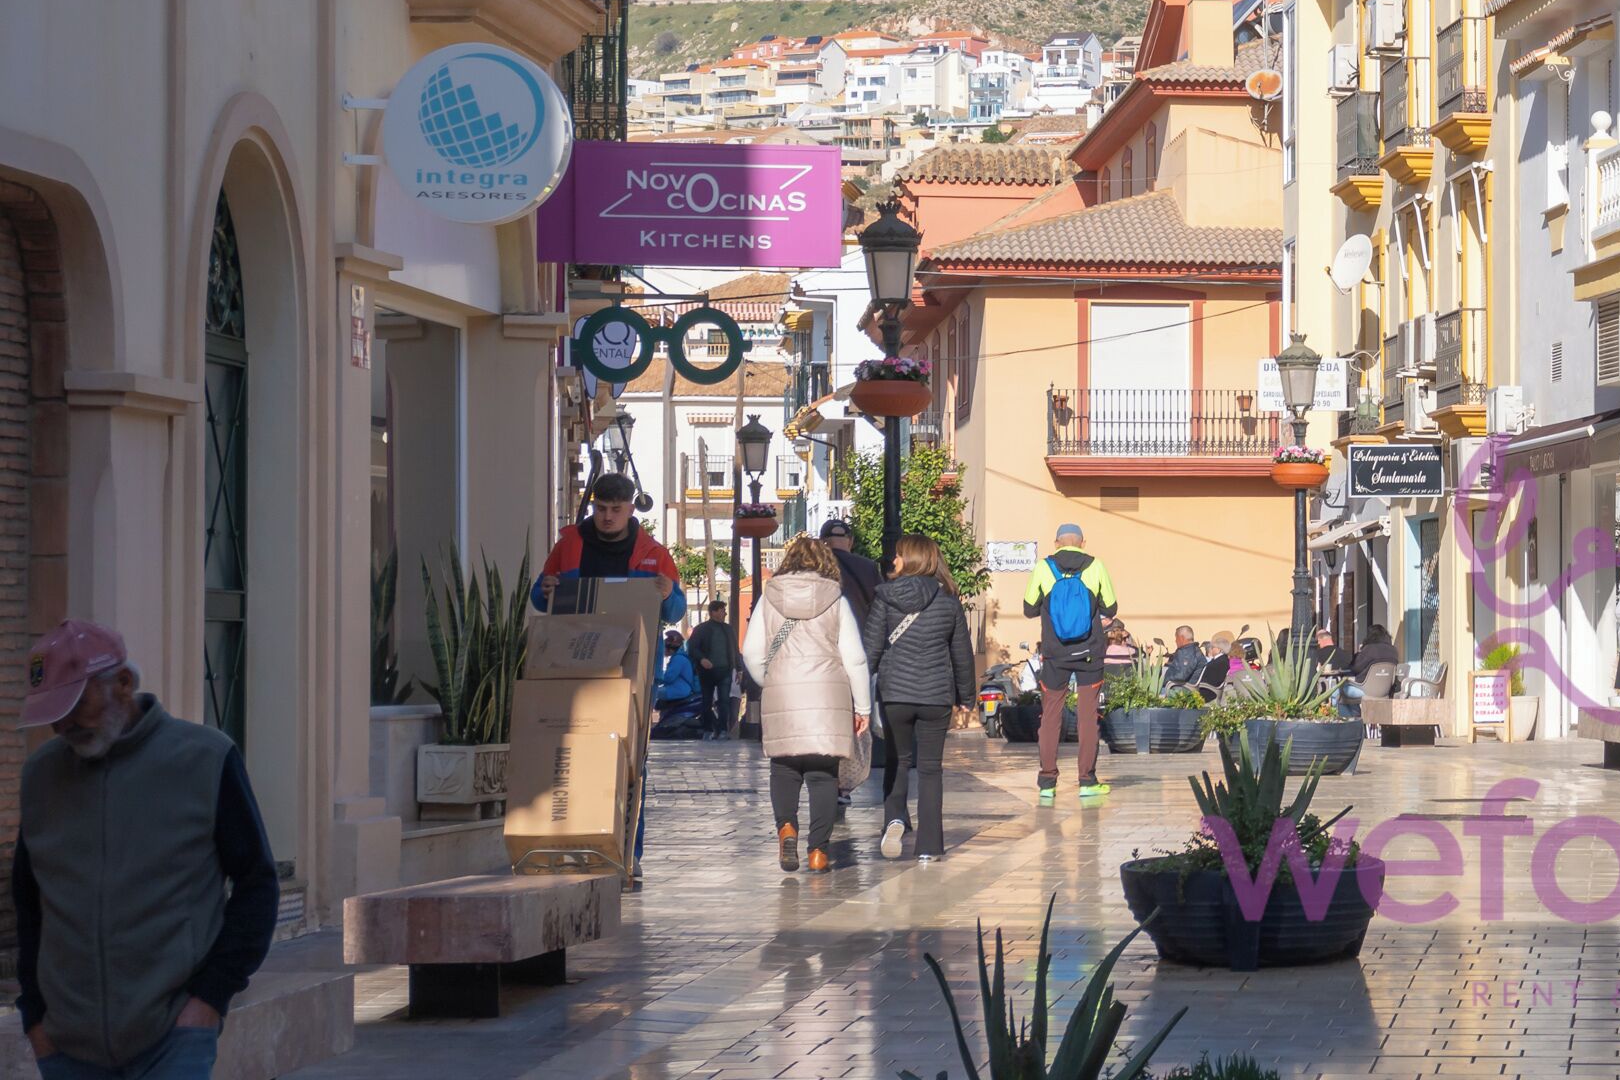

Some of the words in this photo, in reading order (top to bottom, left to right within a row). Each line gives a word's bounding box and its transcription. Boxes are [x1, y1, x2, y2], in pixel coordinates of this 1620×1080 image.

[416, 168, 528, 189] integra
[416, 191, 527, 200] ASESORES
[593, 348, 630, 359] ENTAL
[554, 747, 572, 776] MADE
[553, 777, 570, 788] IN
[551, 790, 569, 822] CHINA
